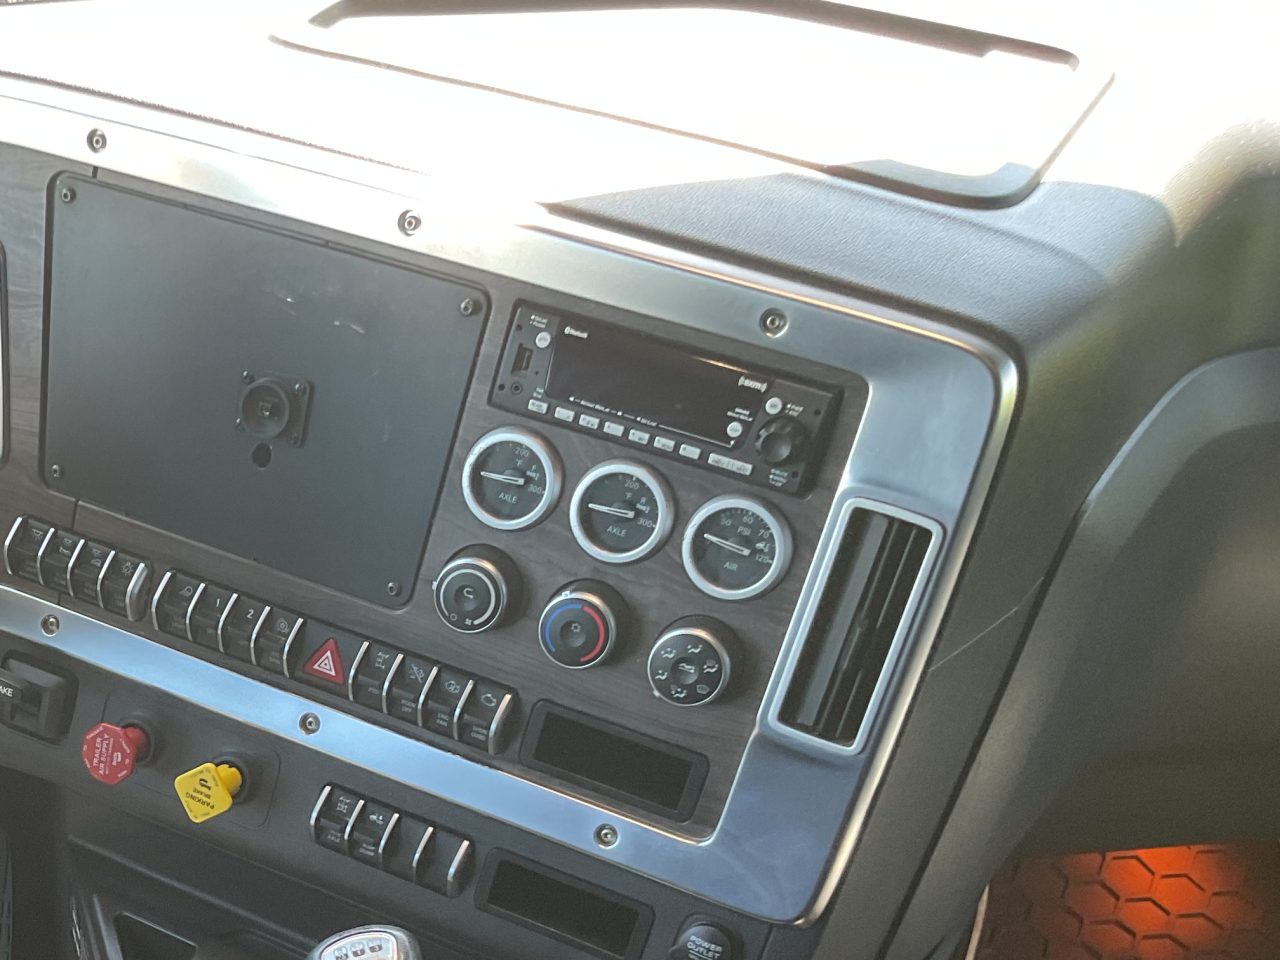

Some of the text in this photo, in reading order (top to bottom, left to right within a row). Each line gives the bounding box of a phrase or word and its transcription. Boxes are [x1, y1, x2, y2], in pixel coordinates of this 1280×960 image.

[498, 492, 518, 504] AXLE
[606, 525, 628, 537] AXLE
[246, 609, 255, 619] 2
[93, 737, 102, 767] TRAILER
[100, 733, 109, 762] SUPPLY
[185, 791, 215, 810] PARKING
[686, 941, 721, 960] OUTLET
[689, 935, 722, 953] POWER
